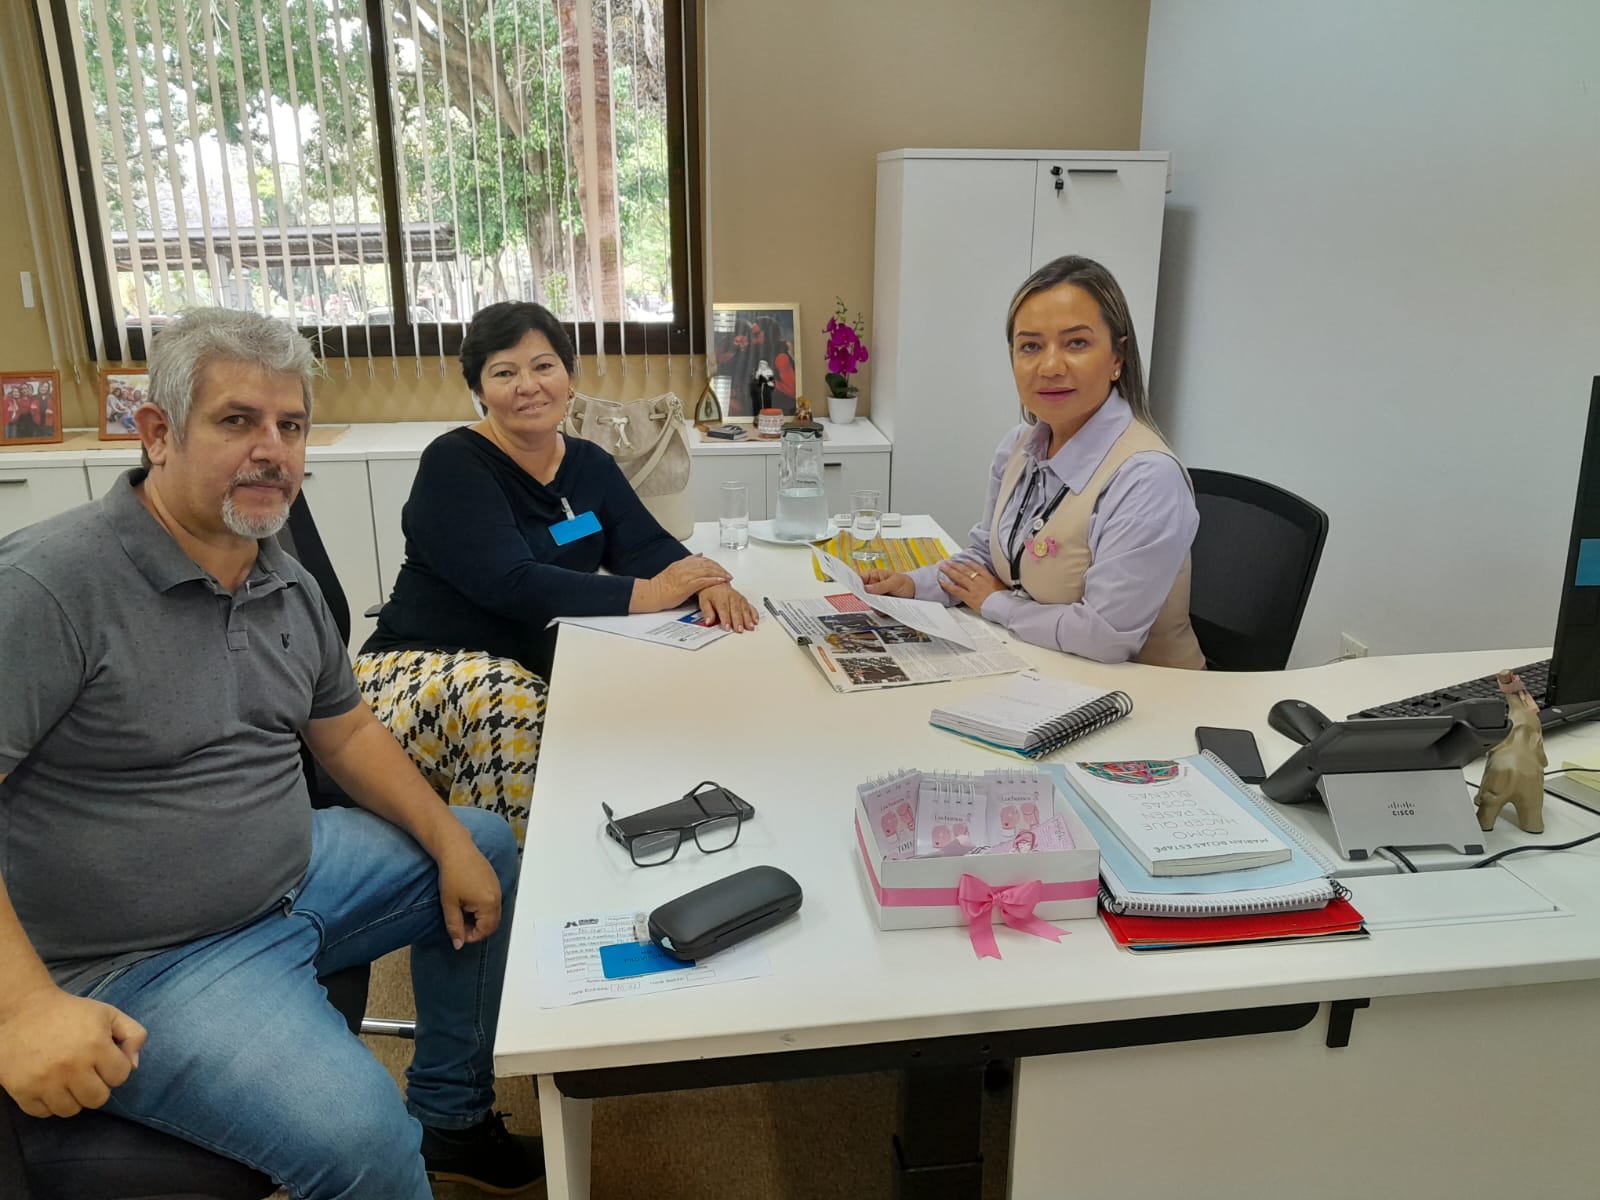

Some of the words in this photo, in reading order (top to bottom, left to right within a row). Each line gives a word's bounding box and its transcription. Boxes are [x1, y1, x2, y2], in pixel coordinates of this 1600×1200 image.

[1127, 790, 1193, 800] BUENAS
[1141, 800, 1198, 810] COSAS
[1141, 809, 1194, 819] PASEN
[1199, 808, 1217, 816] TE
[1392, 809, 1415, 817] CISCO
[1142, 821, 1178, 831] QUE
[1184, 818, 1238, 828] HACER
[1193, 840, 1228, 848] ROJAS
[1228, 837, 1269, 845] MARIAN
